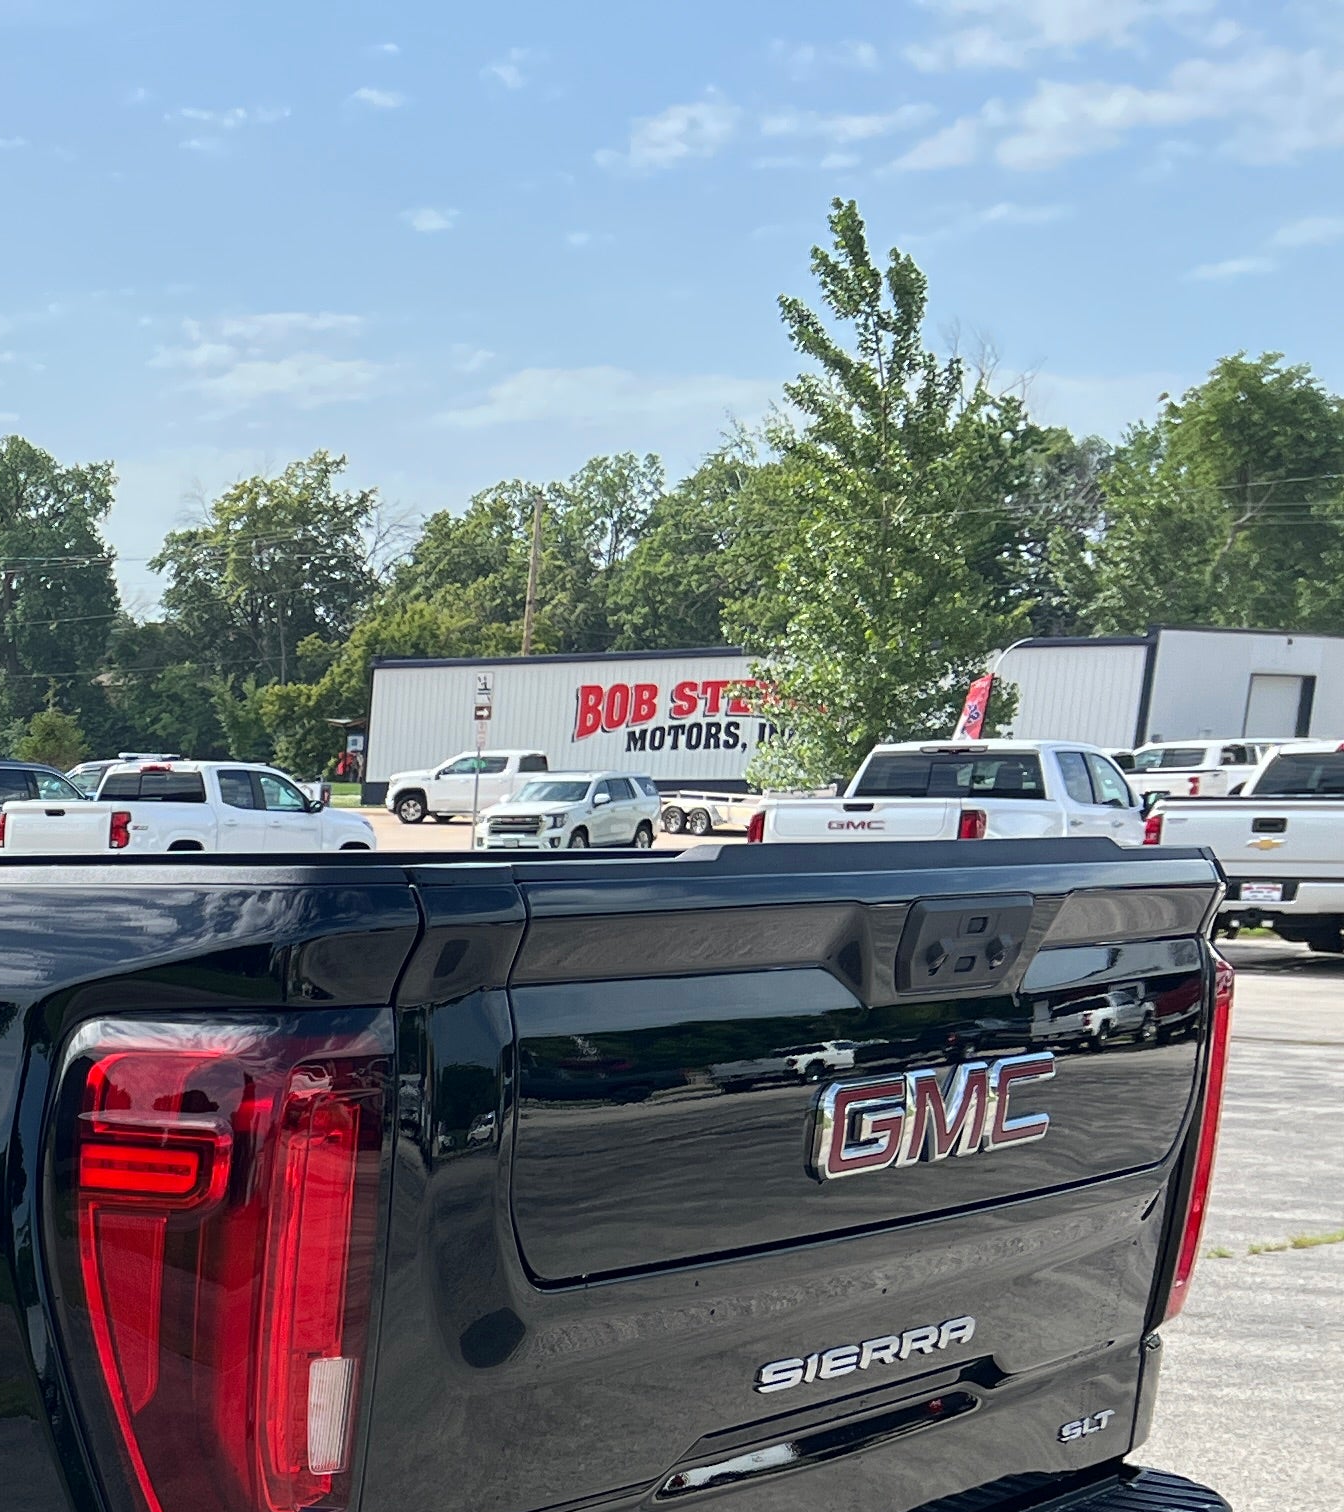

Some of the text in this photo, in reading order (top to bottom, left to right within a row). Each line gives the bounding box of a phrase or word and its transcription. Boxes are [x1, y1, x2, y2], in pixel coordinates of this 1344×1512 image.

[573, 682, 659, 742] BOB
[624, 721, 748, 754] MOTORS,
[827, 819, 885, 830] GMC
[805, 1051, 1056, 1184] GMC
[754, 1315, 976, 1394] SIERRA
[1057, 1409, 1115, 1443] SLT
